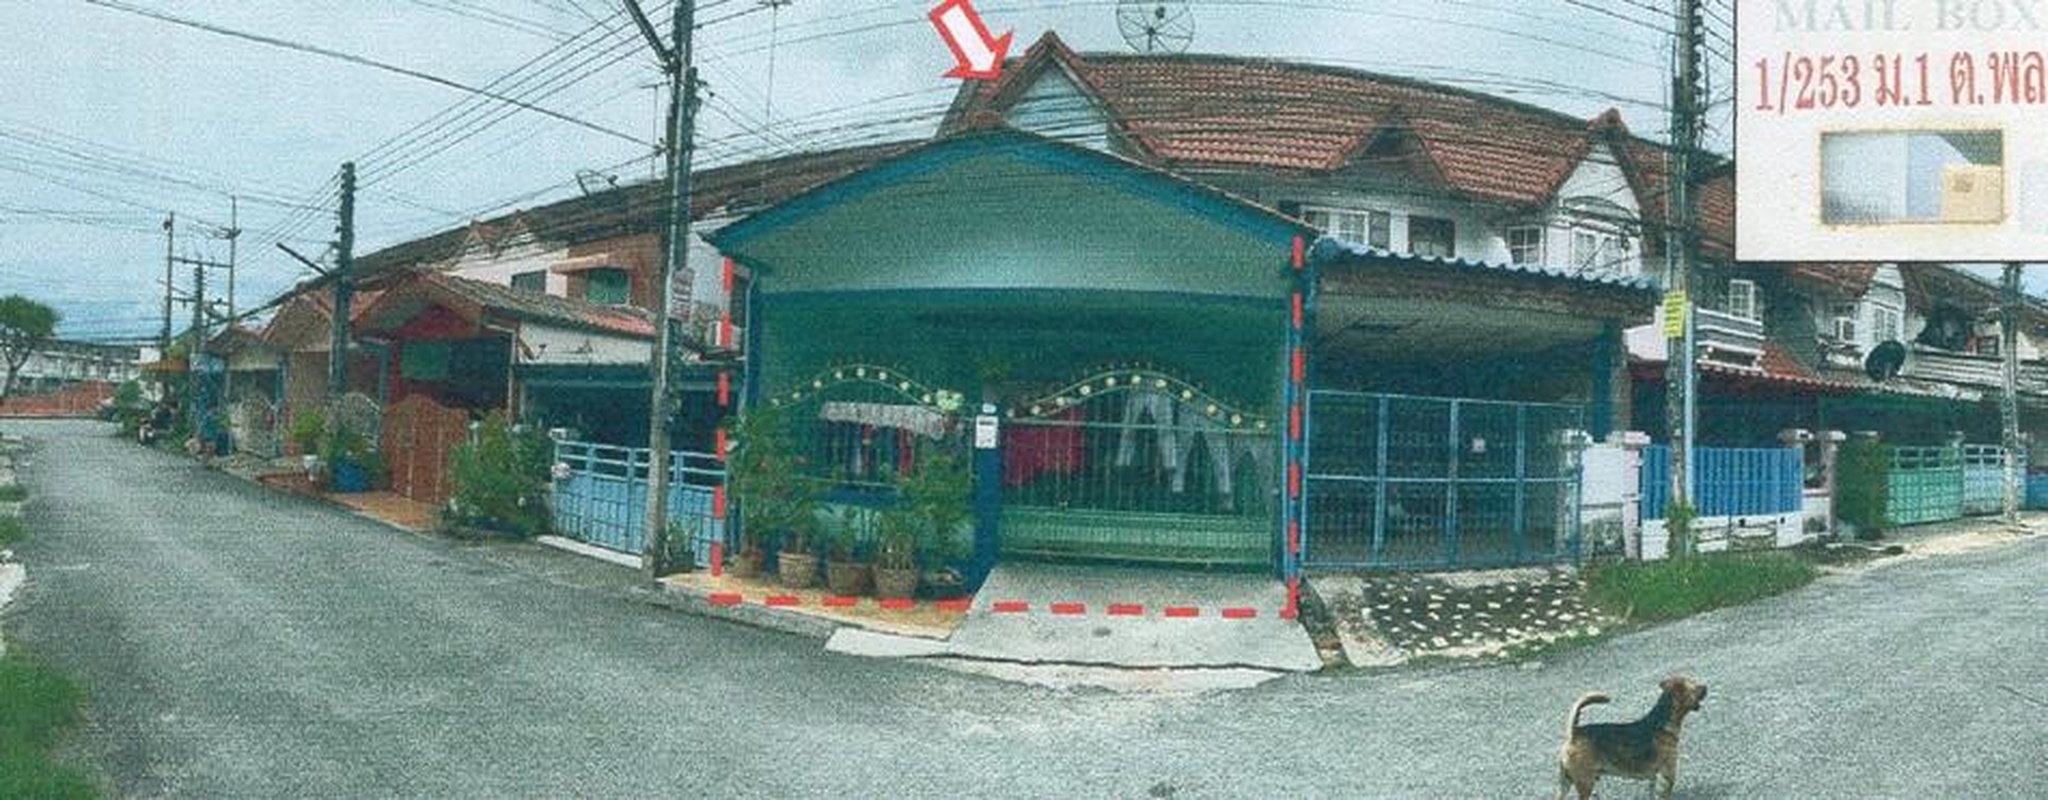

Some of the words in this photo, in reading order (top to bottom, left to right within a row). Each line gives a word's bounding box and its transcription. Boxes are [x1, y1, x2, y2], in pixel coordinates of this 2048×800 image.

[1774, 0, 1912, 31] MAIL
[1937, 0, 2040, 31] BOX
[1755, 51, 1861, 114] 1/253
[1873, 53, 1932, 107] ม.1
